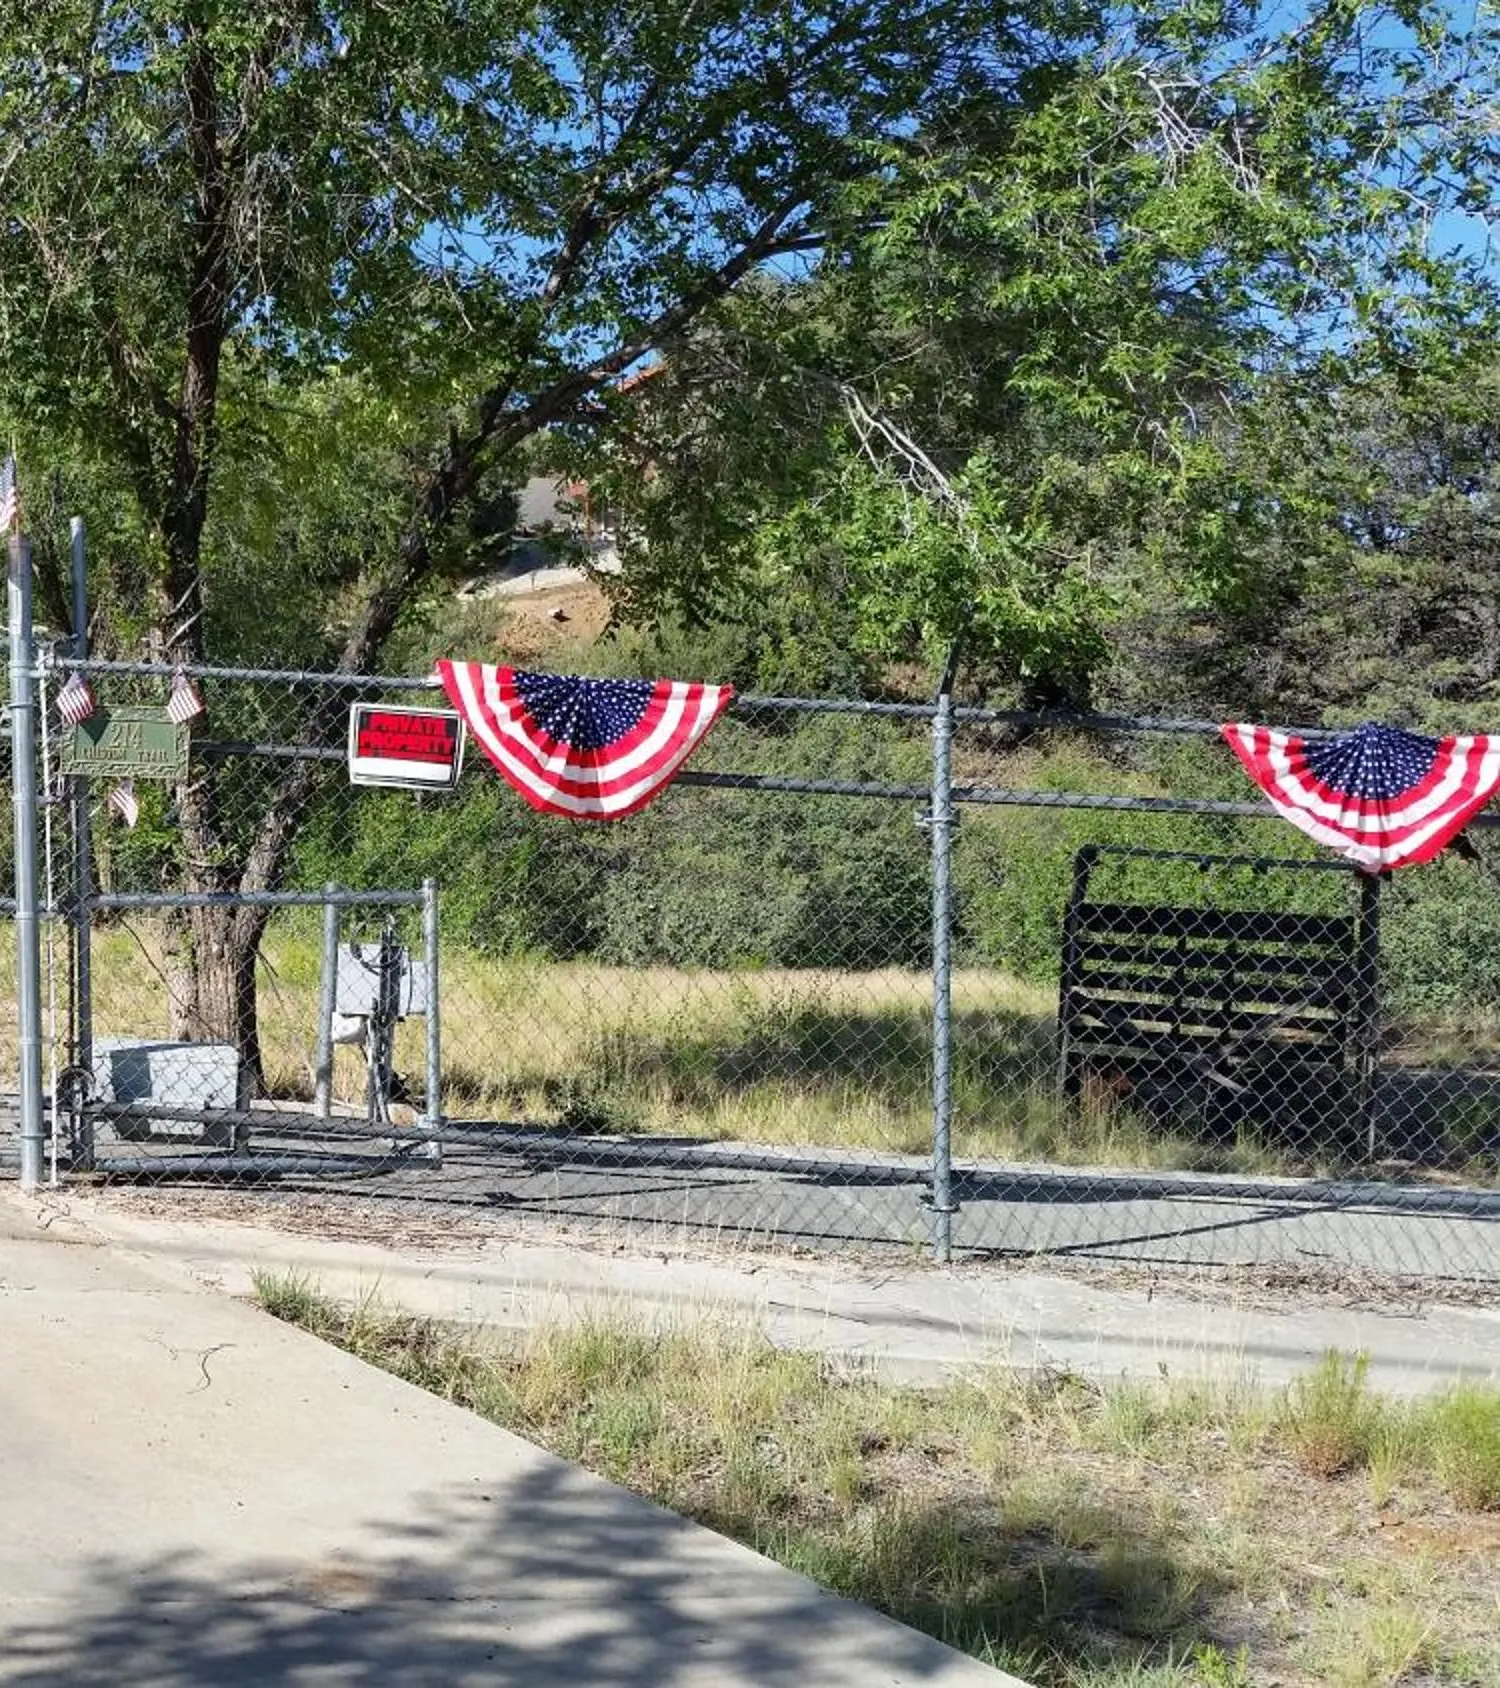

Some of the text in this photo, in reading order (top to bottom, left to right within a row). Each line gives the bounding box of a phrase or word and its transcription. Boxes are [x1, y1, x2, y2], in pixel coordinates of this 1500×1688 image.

[108, 721, 143, 749] 214
[369, 713, 446, 737] PRIVATE
[137, 747, 169, 763] TRAIL
[359, 731, 454, 755] PROPERTY
